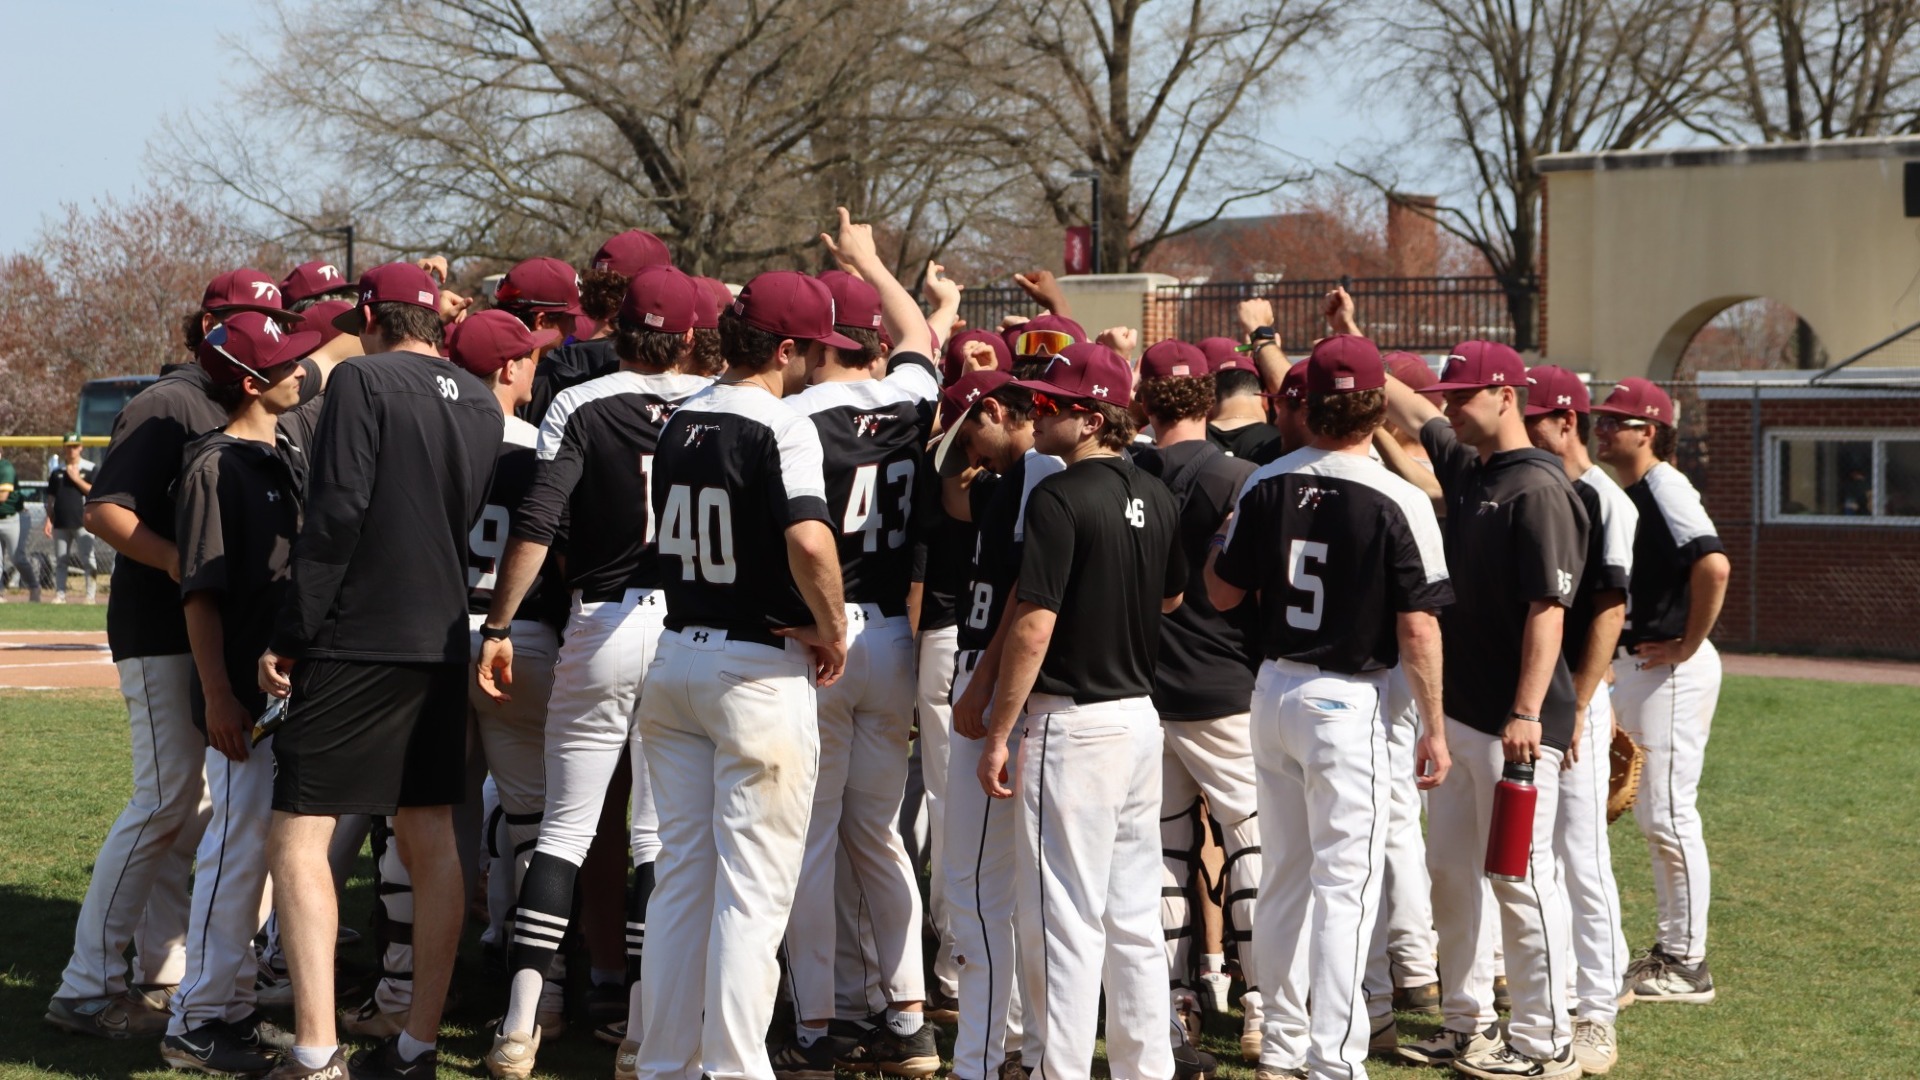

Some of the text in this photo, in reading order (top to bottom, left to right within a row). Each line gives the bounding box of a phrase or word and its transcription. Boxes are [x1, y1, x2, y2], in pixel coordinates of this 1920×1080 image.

[436, 375, 459, 401] 30
[468, 503, 510, 590] 9
[658, 484, 737, 584] 40
[843, 458, 915, 553] 43
[1125, 497, 1145, 528] 46
[1286, 539, 1328, 631] 5
